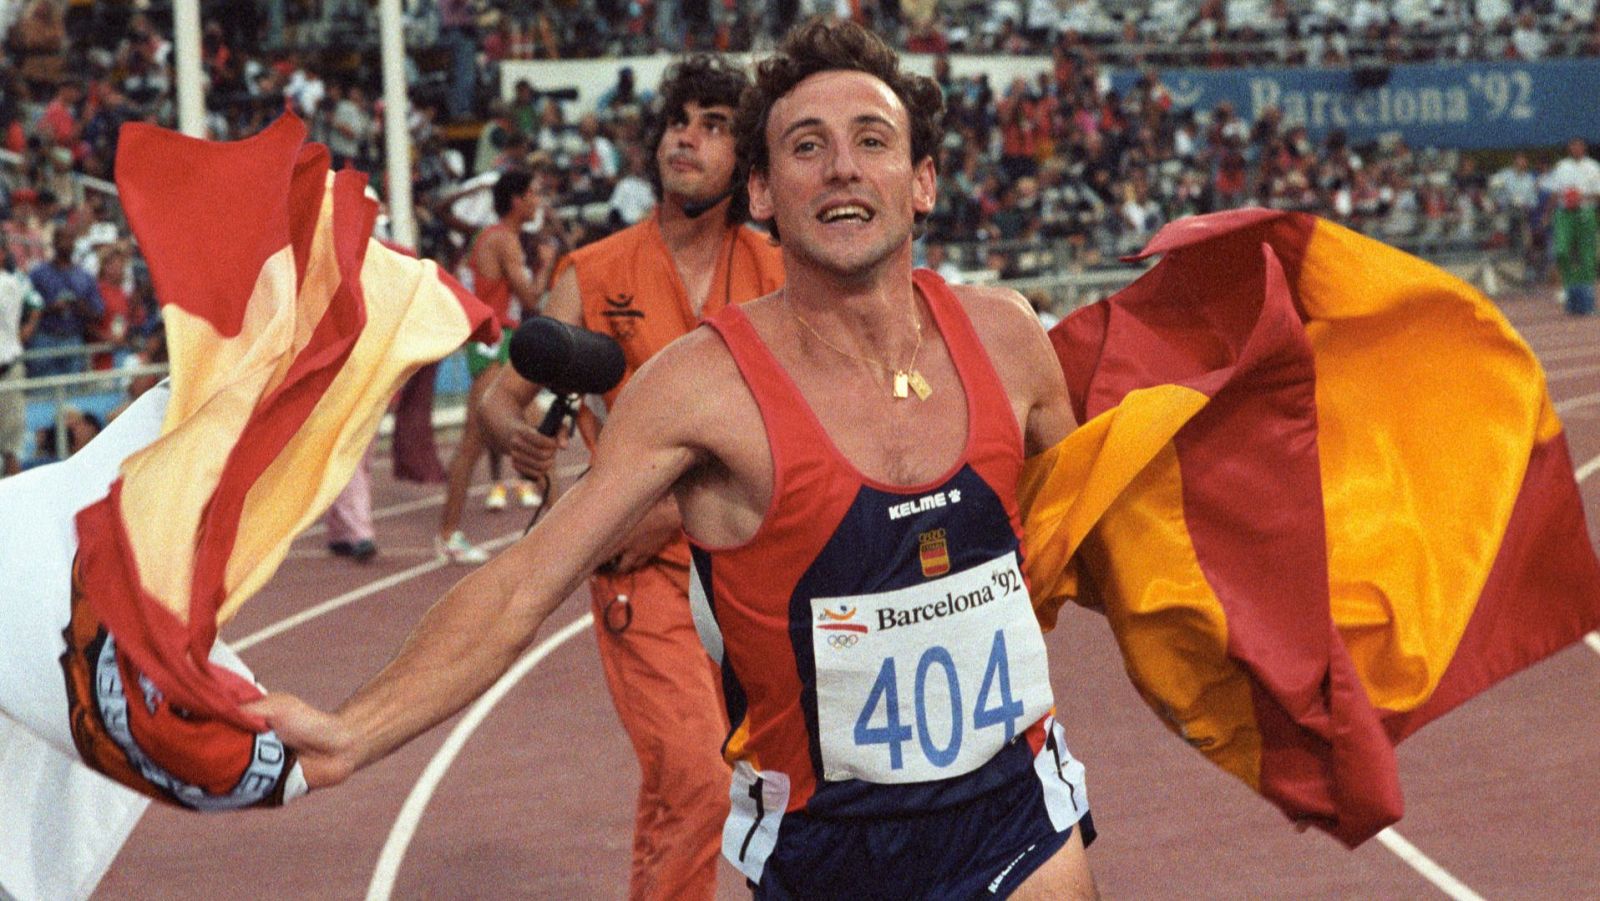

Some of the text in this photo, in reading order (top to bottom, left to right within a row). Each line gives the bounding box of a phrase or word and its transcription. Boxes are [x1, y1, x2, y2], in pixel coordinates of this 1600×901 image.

[1250, 79, 1468, 128] Barcelona
[889, 491, 947, 520] KELME
[876, 586, 995, 631] Barcelona
[853, 629, 1024, 770] 404
[739, 777, 764, 863] 1
